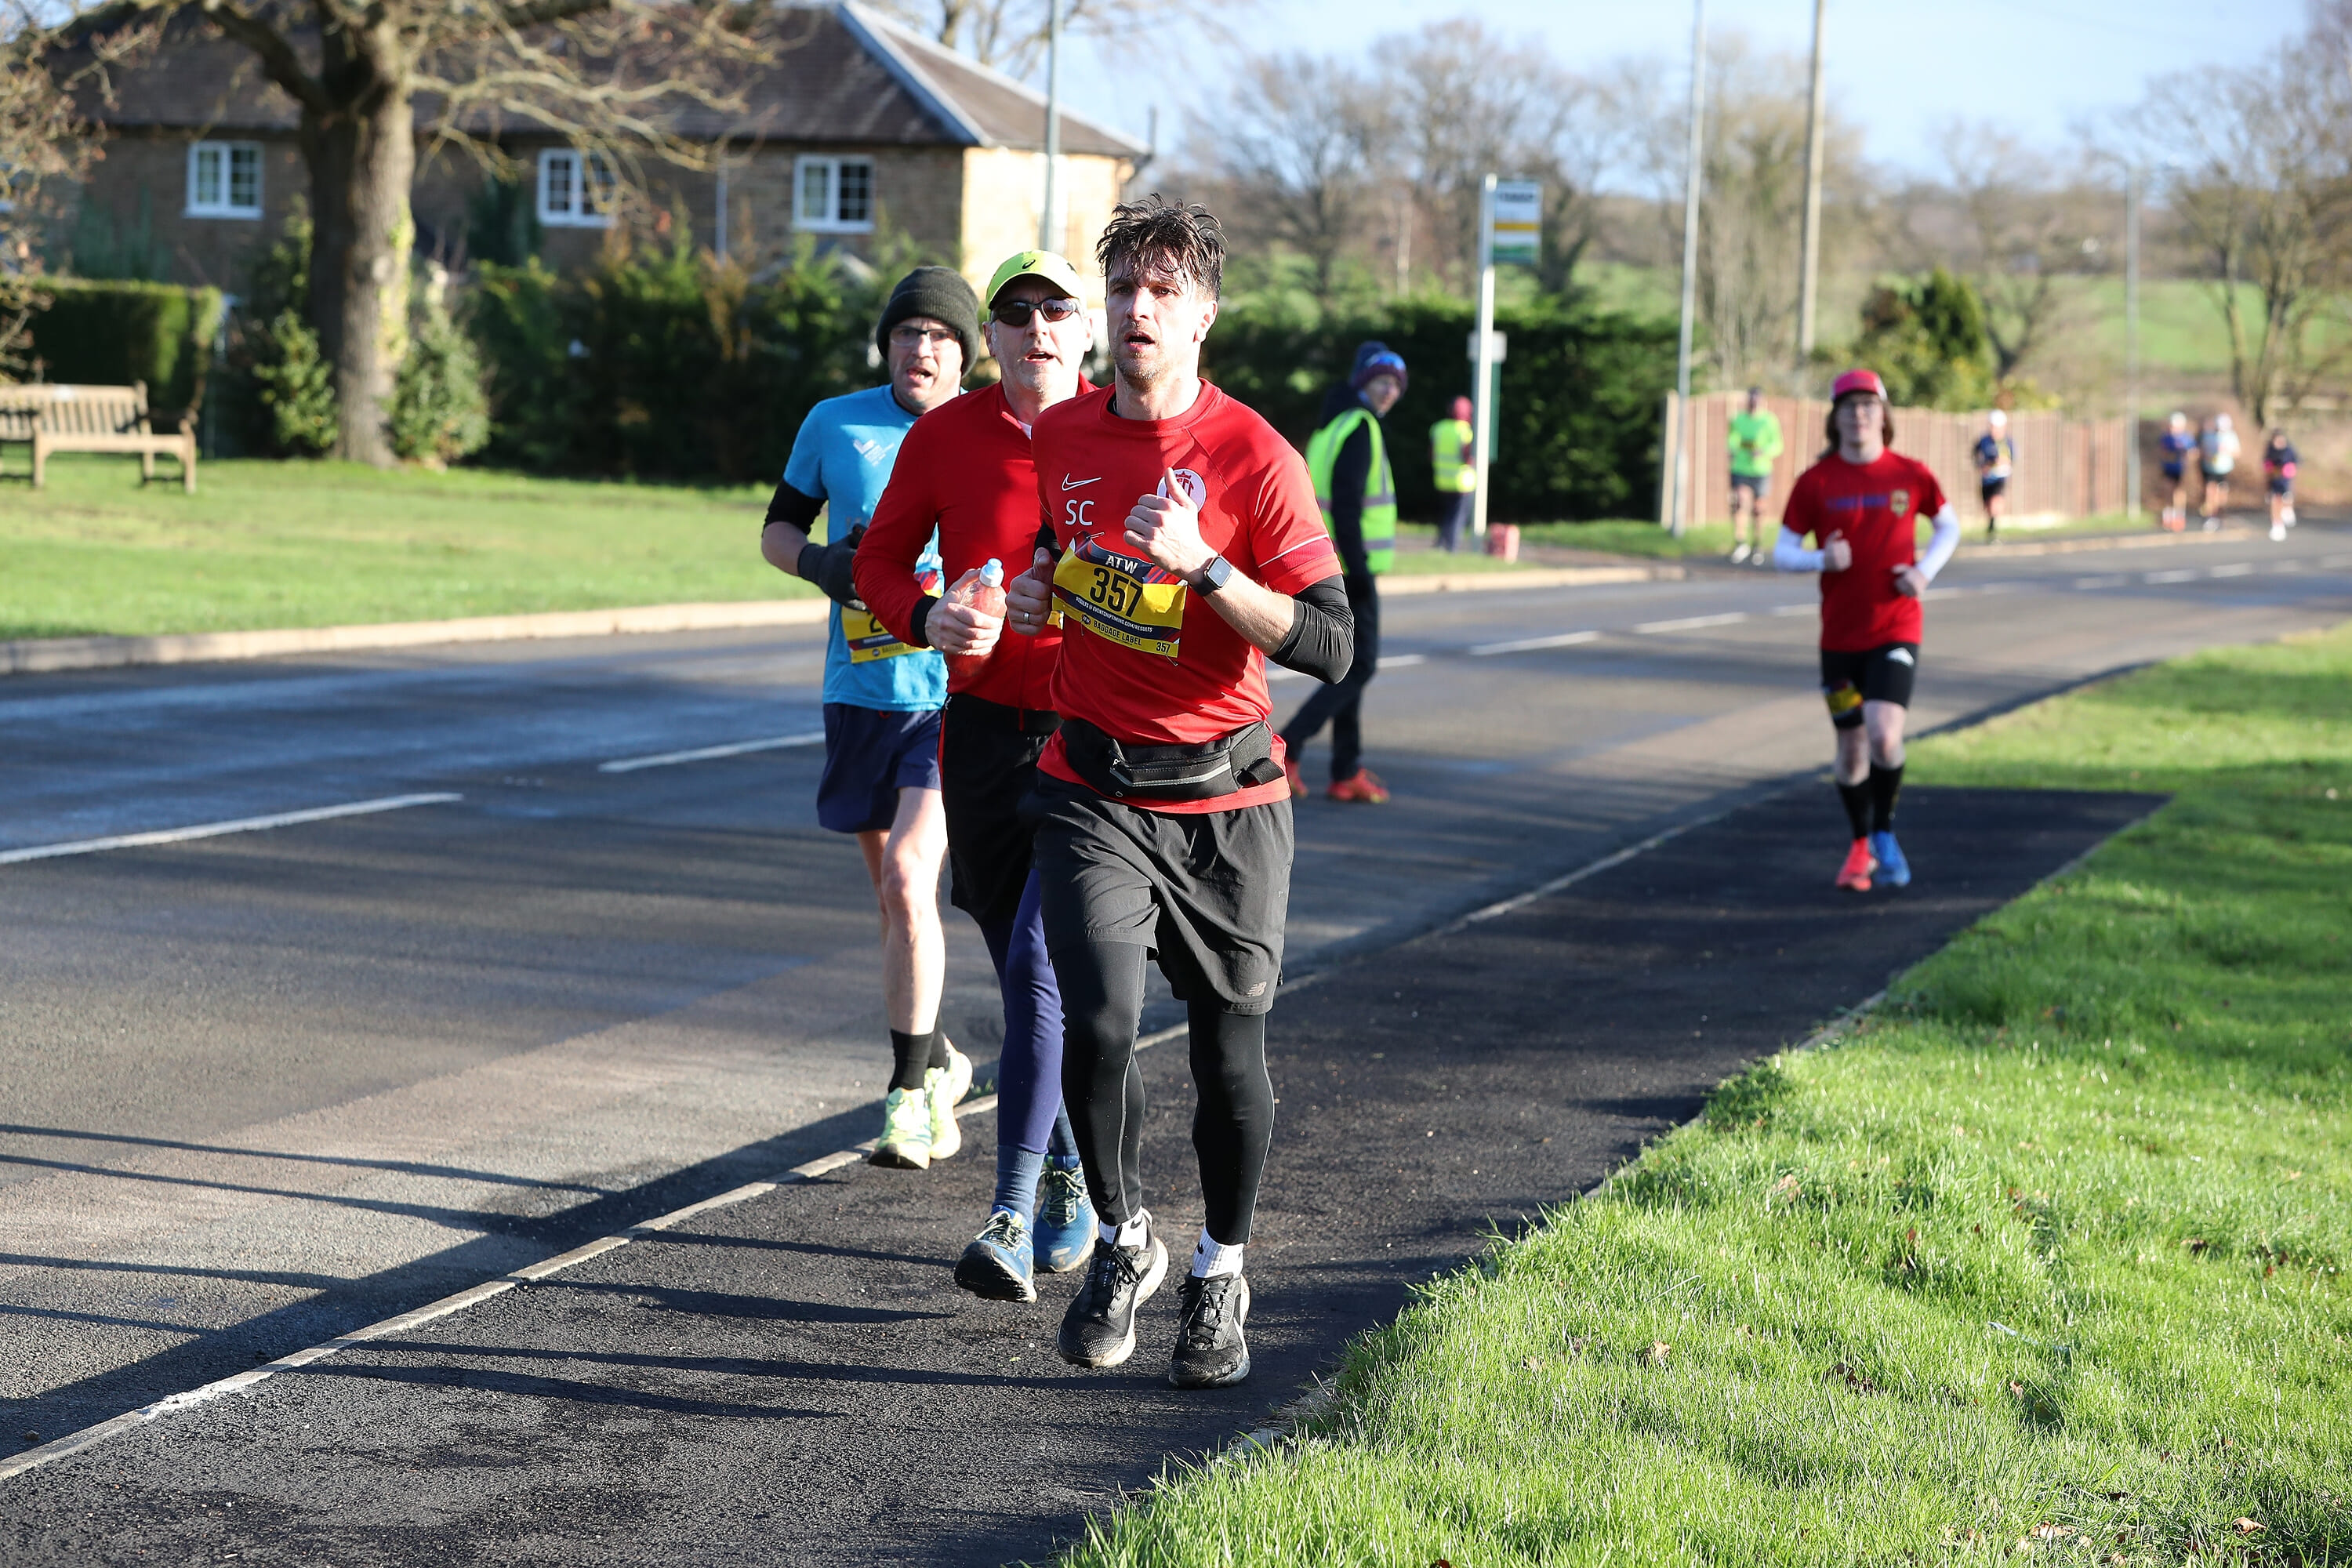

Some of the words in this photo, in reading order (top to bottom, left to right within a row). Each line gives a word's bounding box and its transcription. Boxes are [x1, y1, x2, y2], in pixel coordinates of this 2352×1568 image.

[1065, 499, 1094, 526] SC
[1105, 554, 1138, 575] ATW
[1089, 567, 1143, 618] 357
[1075, 596, 1089, 608] RESULTS
[1092, 606, 1153, 633] EVENTCHIPTIMING.COM/RESULTS
[1093, 620, 1121, 638] BAGGAGE
[1121, 633, 1142, 646] LABEL
[1156, 641, 1171, 654] 357
